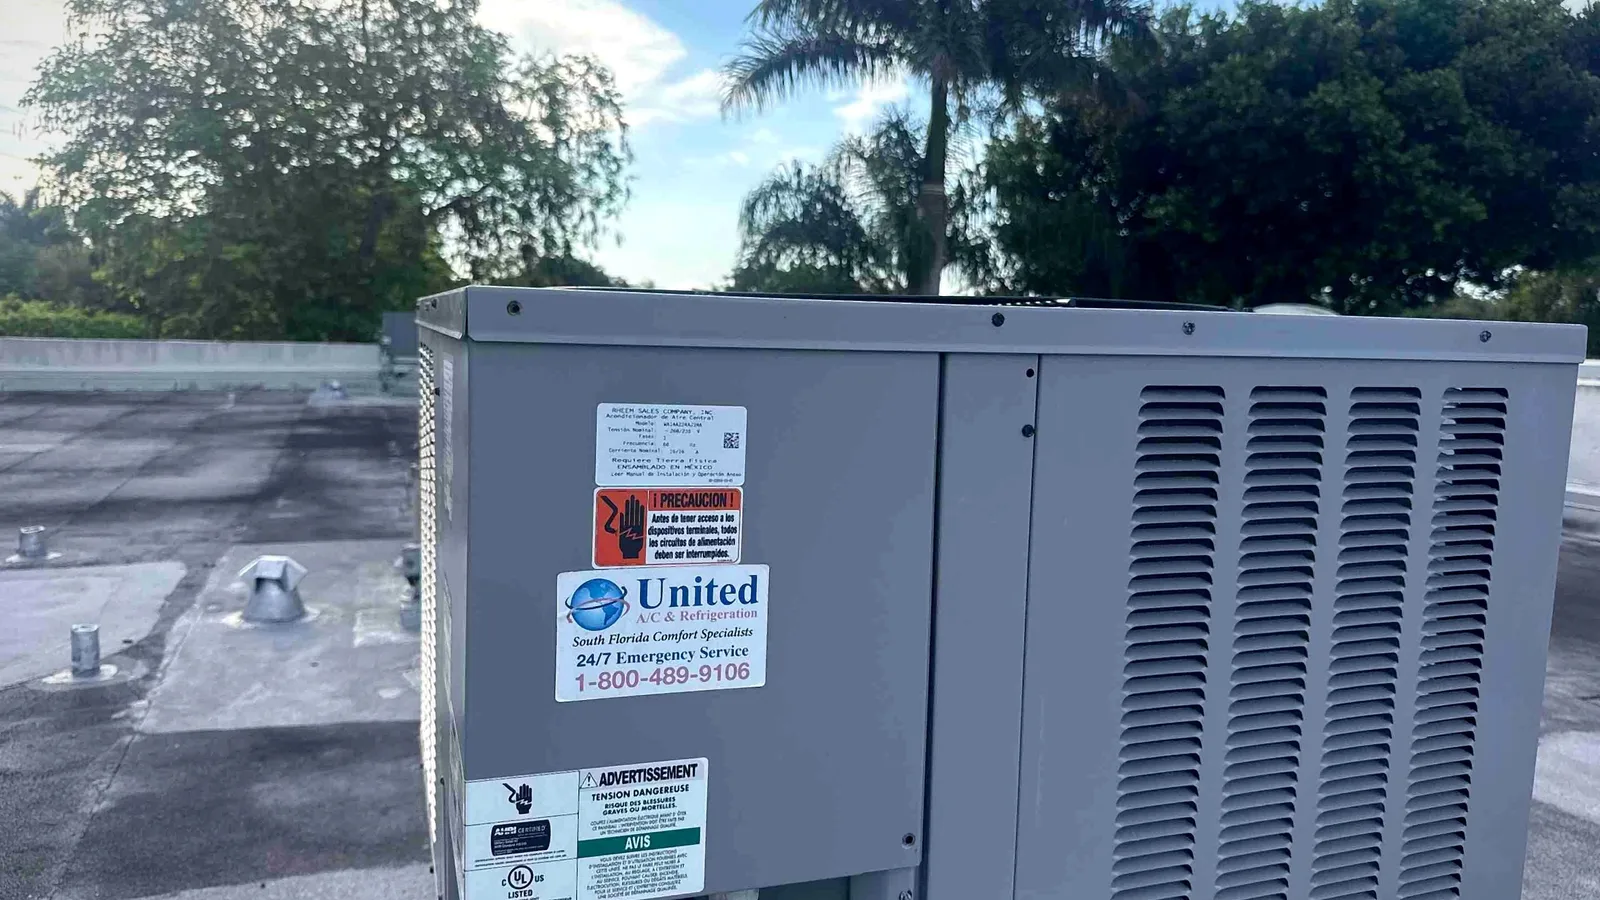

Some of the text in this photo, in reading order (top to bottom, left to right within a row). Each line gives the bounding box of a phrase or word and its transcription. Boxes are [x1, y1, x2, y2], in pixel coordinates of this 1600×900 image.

[660, 492, 727, 508] PRECAUCION
[730, 492, 734, 507] !
[652, 514, 670, 523] Antes
[671, 514, 679, 523] de
[680, 514, 696, 523] tener
[698, 514, 718, 522] acceso
[726, 513, 735, 522] los
[648, 525, 738, 537] dispositivos terminales, todos
[649, 538, 658, 548] los
[660, 538, 686, 547] circuitos
[688, 537, 696, 546] de
[654, 548, 729, 560] deben ser interrumpidos.
[636, 574, 758, 610] United
[636, 608, 758, 624] A/C & Refrigeration
[572, 626, 754, 648] South Florida Comfort Specialists
[576, 645, 749, 667] 24/7 Emergency Service
[575, 662, 750, 692] 1-800-489-9106
[599, 763, 698, 787] ADVERTISSEMENT
[592, 784, 690, 801] TENSION DANGEREUSE
[641, 803, 678, 812] MORTELLES.
[642, 796, 676, 805] BLESSURES
[494, 826, 517, 836] AHRI
[625, 835, 651, 850] AVIS
[508, 889, 533, 899] LISTED
